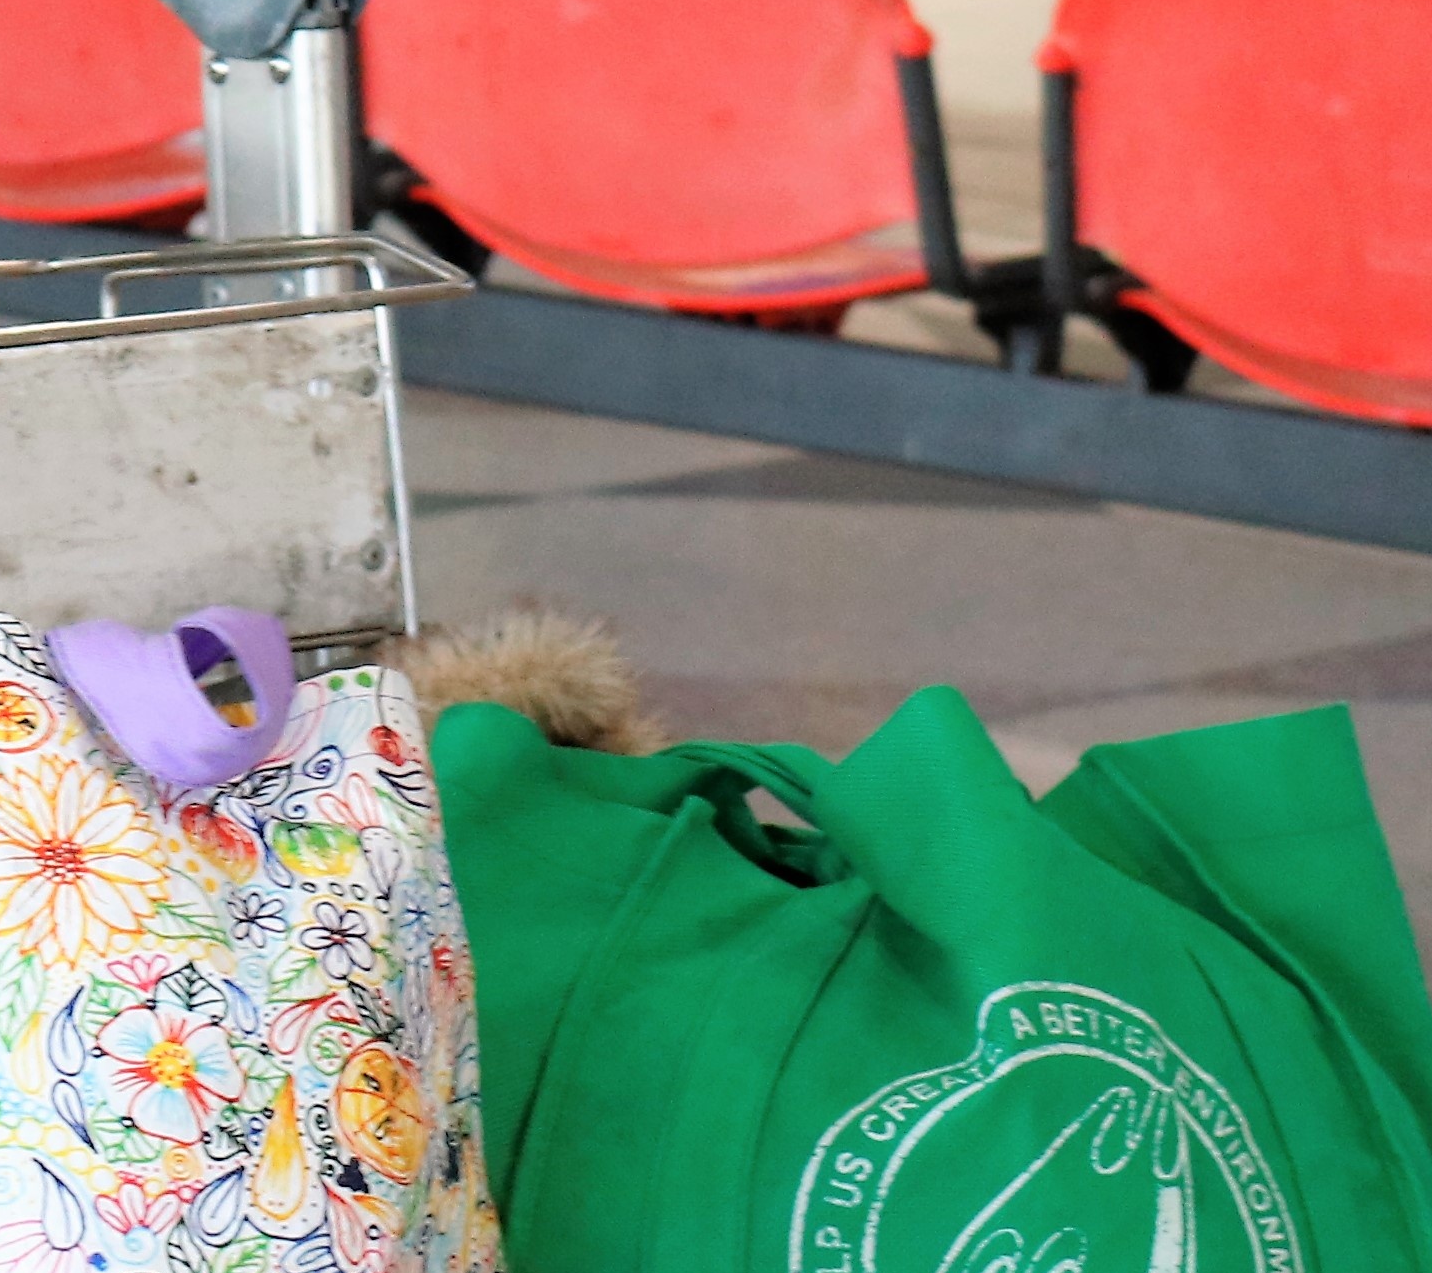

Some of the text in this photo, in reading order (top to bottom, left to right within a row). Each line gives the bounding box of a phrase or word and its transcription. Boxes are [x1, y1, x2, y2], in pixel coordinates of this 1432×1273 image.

[823, 1150, 874, 1207] US
[1009, 1007, 1038, 1040] A
[1038, 1002, 1167, 1073] BETTER
